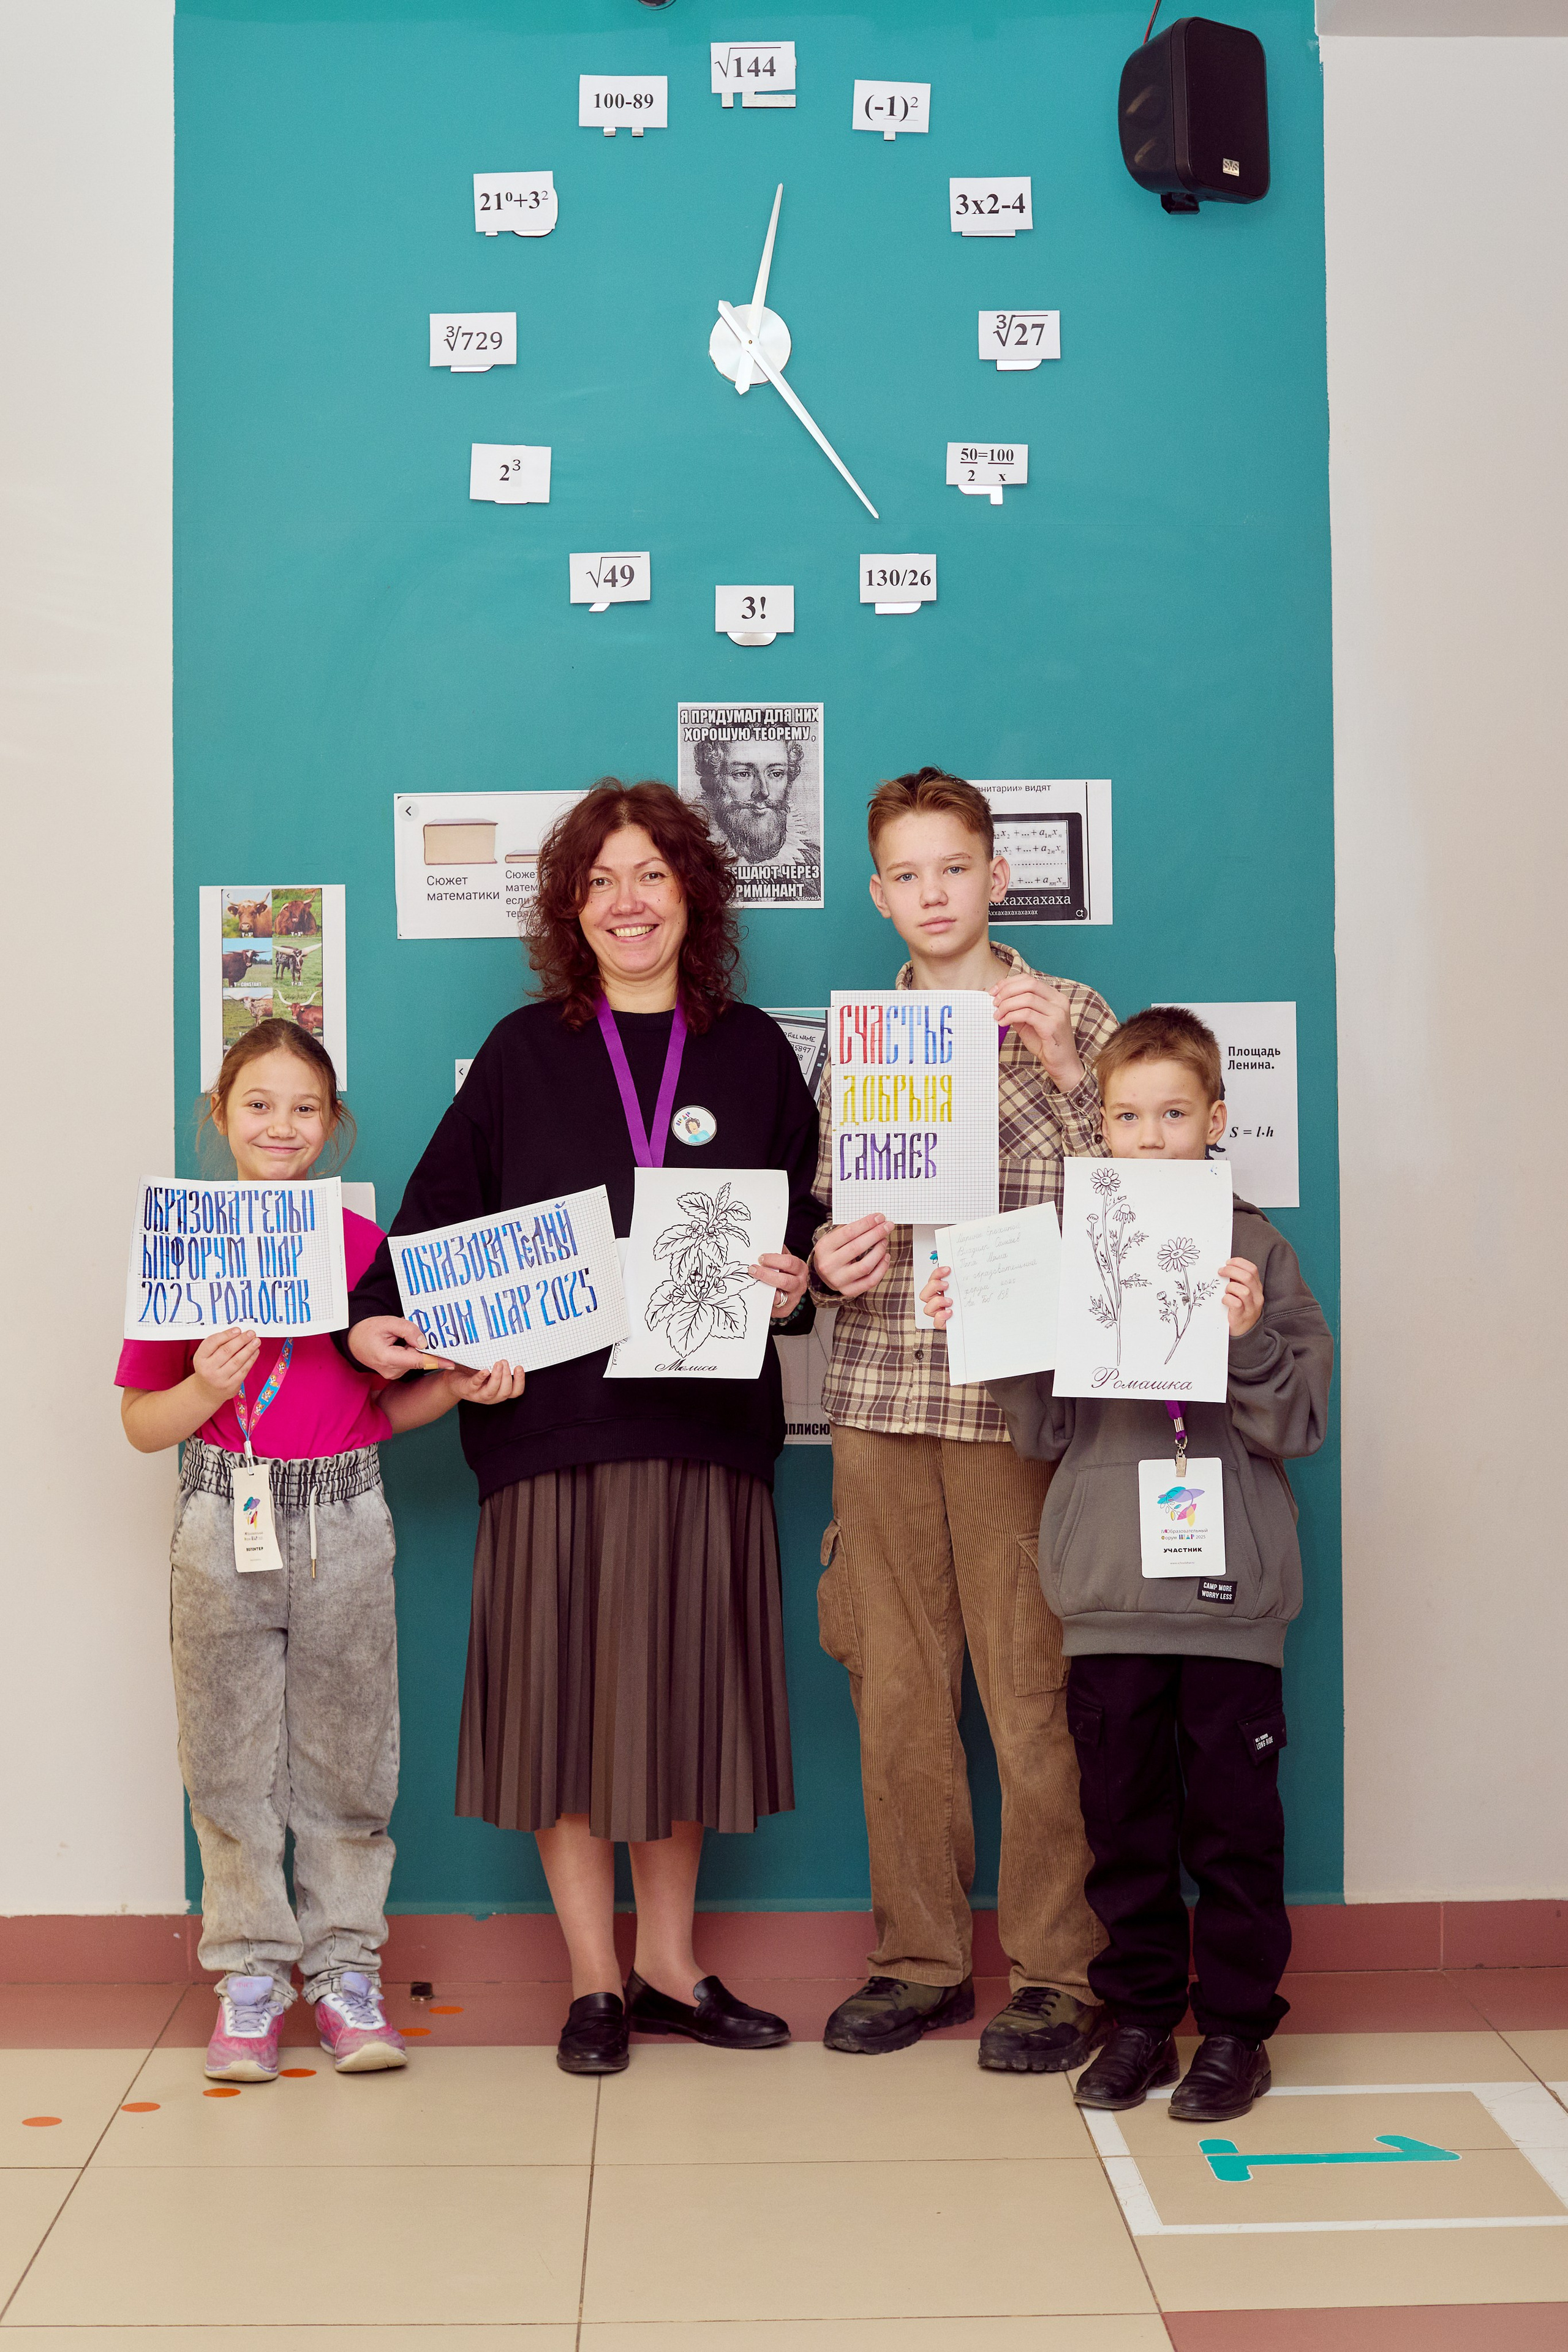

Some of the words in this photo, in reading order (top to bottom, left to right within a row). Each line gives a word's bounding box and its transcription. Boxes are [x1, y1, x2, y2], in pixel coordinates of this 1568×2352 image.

[595, 93, 654, 109] 100-89
[865, 569, 931, 586] 130/26
[741, 596, 766, 619] 3!
[680, 709, 688, 723] Я
[692, 709, 761, 726] ПРИДУМАЛ
[764, 709, 793, 724] ДЛЯ
[794, 708, 820, 722] НИХ
[684, 726, 750, 742] ХОРОШУЮ
[734, 866, 779, 880] ЕШАЮТ
[782, 865, 820, 879] ЧЕРЕЗ
[427, 875, 468, 886] Сюжет
[427, 891, 500, 901] математики
[736, 883, 805, 898] РИМИНАНТ
[839, 1005, 953, 1065] СЧАСТЬЕ
[1228, 1046, 1281, 1057] Площадь
[1227, 1060, 1275, 1071] Ленина.
[1229, 1126, 1239, 1138] S
[840, 1133, 938, 1181] САМАЕВ
[257, 1234, 303, 1279] ШАР
[987, 1252, 1009, 1262] Мама
[480, 1284, 532, 1340] ШАР
[536, 1267, 598, 1327] 2025
[1091, 1366, 1193, 1390] Ромашка
[785, 1423, 832, 1437] ПЛИСЮ
[1203, 1582, 1218, 1591] CAMP
[1202, 1591, 1219, 1599] WORRY
[1256, 1740, 1266, 1750] LONG
